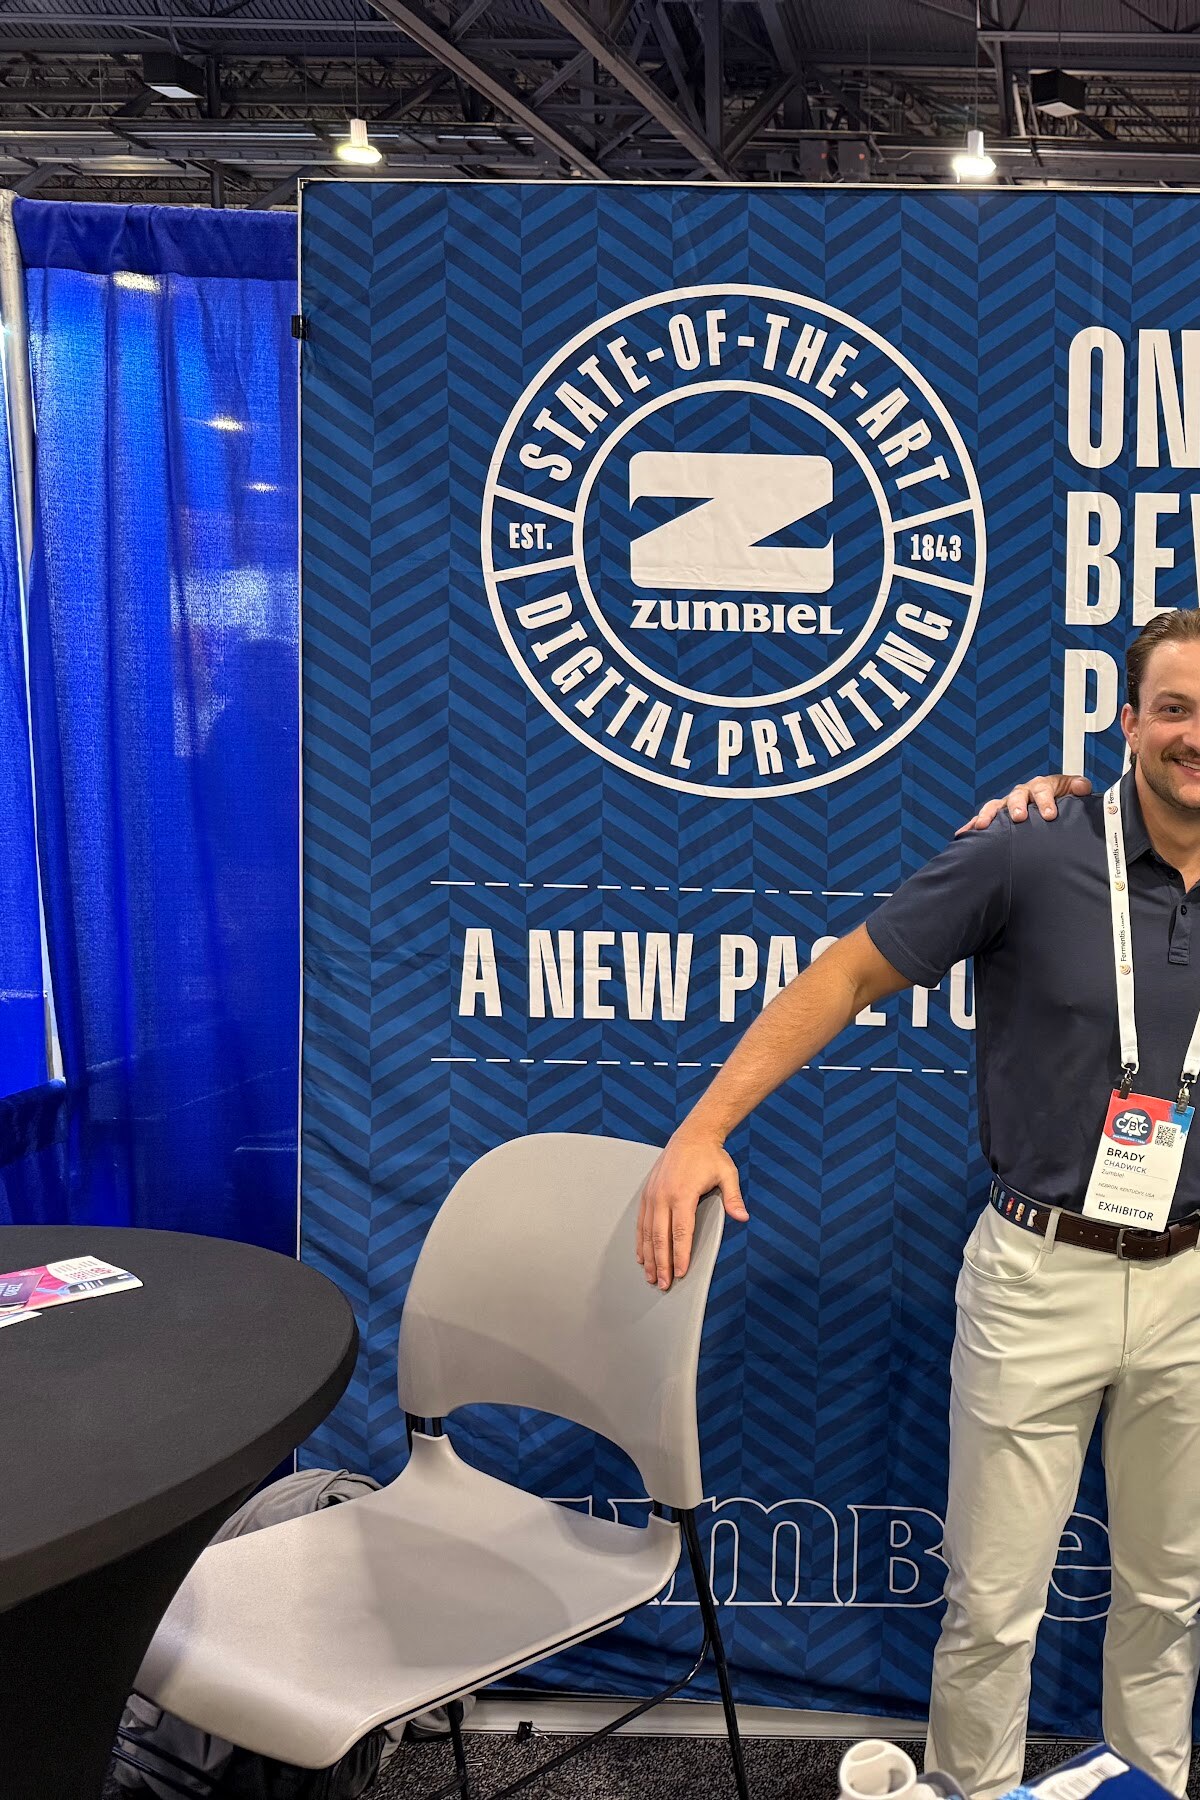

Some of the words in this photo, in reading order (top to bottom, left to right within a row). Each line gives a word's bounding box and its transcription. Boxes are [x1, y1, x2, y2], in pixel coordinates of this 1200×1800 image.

[519, 310, 950, 490] STATE-OF-THE-ART
[509, 523, 552, 550] EST.
[910, 534, 962, 562] 1843
[516, 592, 693, 770] DIGITAL
[717, 603, 953, 776] PRINTING
[459, 928, 502, 1017] A
[528, 929, 694, 1021] NEW
[1115, 1117, 1149, 1134] CBC
[1103, 1160, 1147, 1174] CHADWICK
[1106, 1147, 1145, 1163] BRADY
[1098, 1201, 1154, 1221] EXHIBITOR
